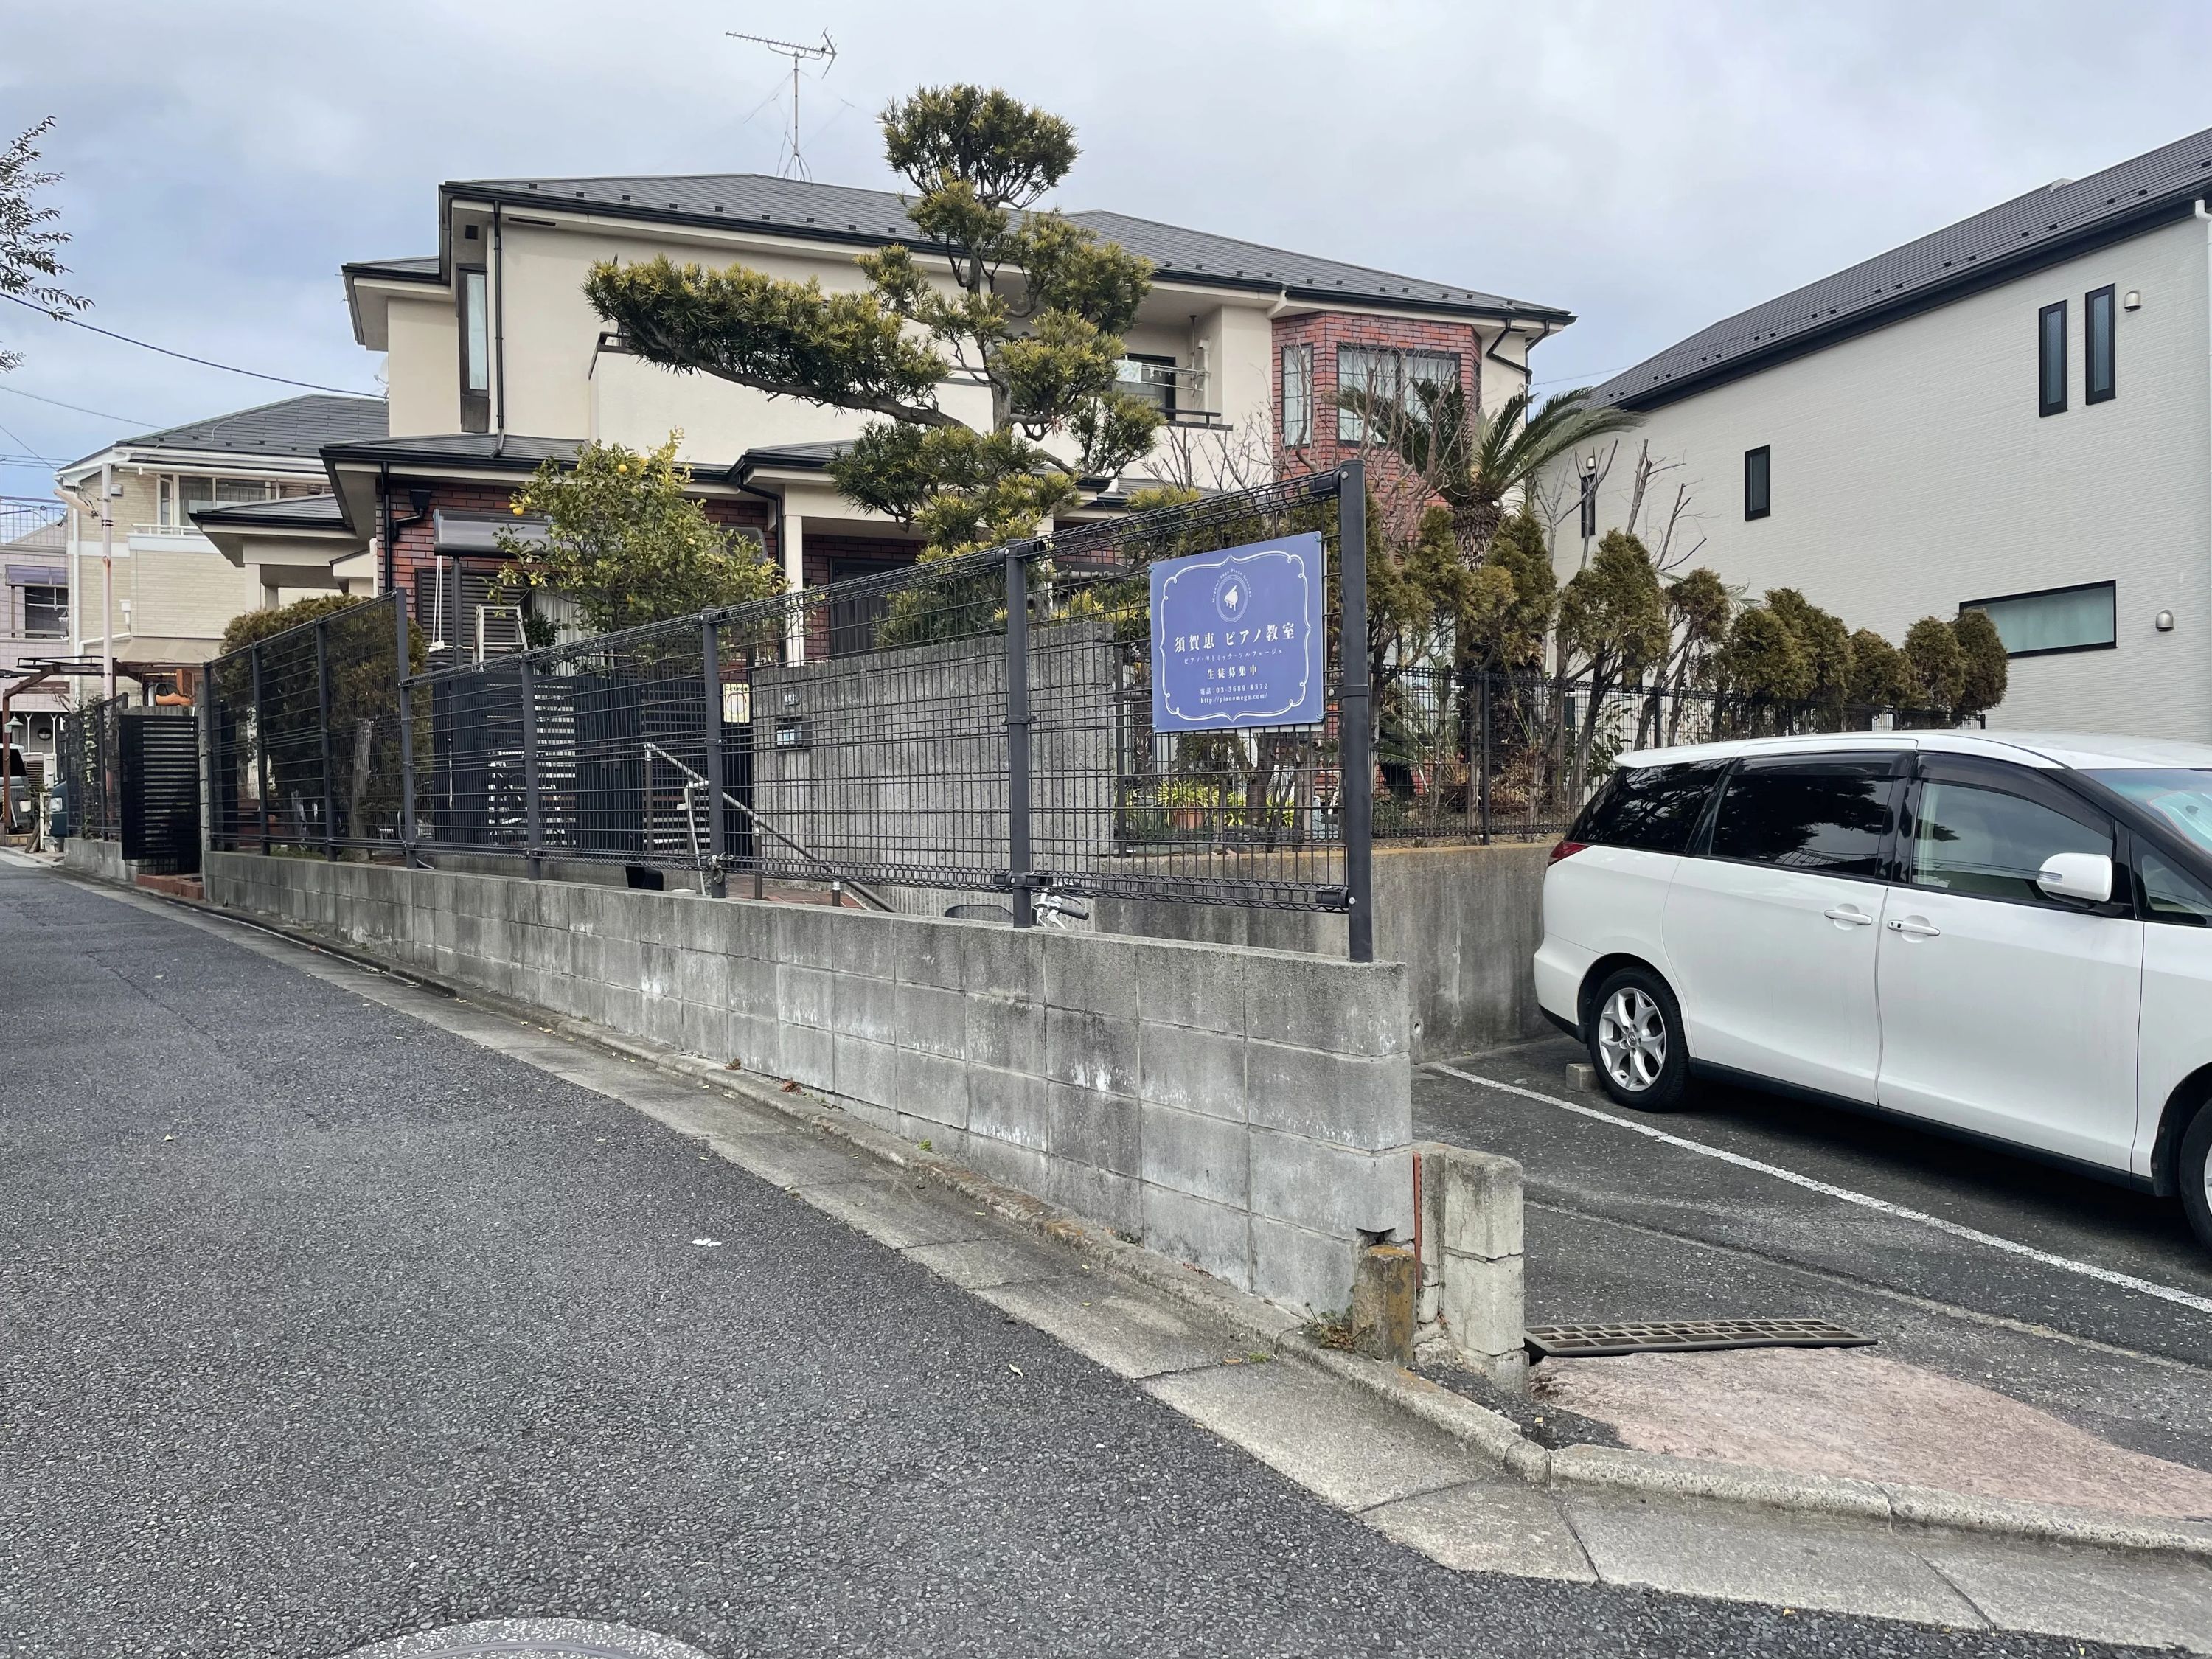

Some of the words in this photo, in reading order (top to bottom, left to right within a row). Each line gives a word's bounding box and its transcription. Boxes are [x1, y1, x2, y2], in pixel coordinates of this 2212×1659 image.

[1225, 622, 1295, 647] ピアノ教室
[1207, 664, 1257, 680] 生徒募集中
